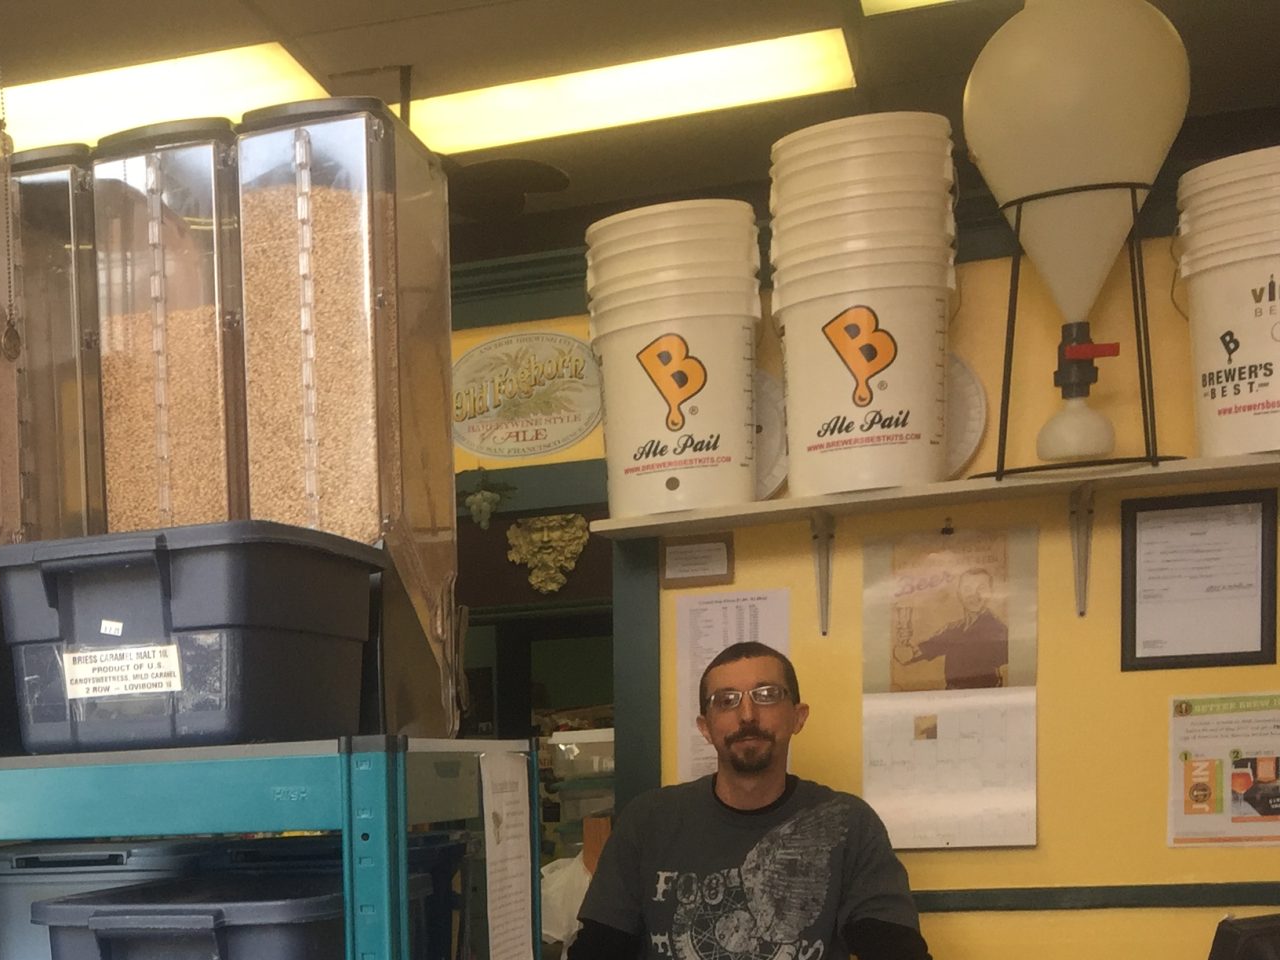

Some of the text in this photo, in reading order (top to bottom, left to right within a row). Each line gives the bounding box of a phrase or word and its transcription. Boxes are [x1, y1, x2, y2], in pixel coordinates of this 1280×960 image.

[492, 354, 586, 409] Foghorn
[1201, 362, 1274, 388] BREWER'S
[816, 409, 910, 438] Ale Pail
[633, 433, 721, 461] Ale Pail
[894, 570, 956, 598] Beer
[72, 654, 98, 666] BRIESS
[100, 652, 133, 664] CARAMEL
[136, 649, 156, 660] MALT
[92, 665, 130, 674] PRODUCT
[133, 663, 144, 671] OF
[92, 685, 110, 694] ROW
[124, 682, 163, 691] LOVIBOND
[132, 673, 149, 681] MILD
[151, 671, 177, 679] CARAMEL
